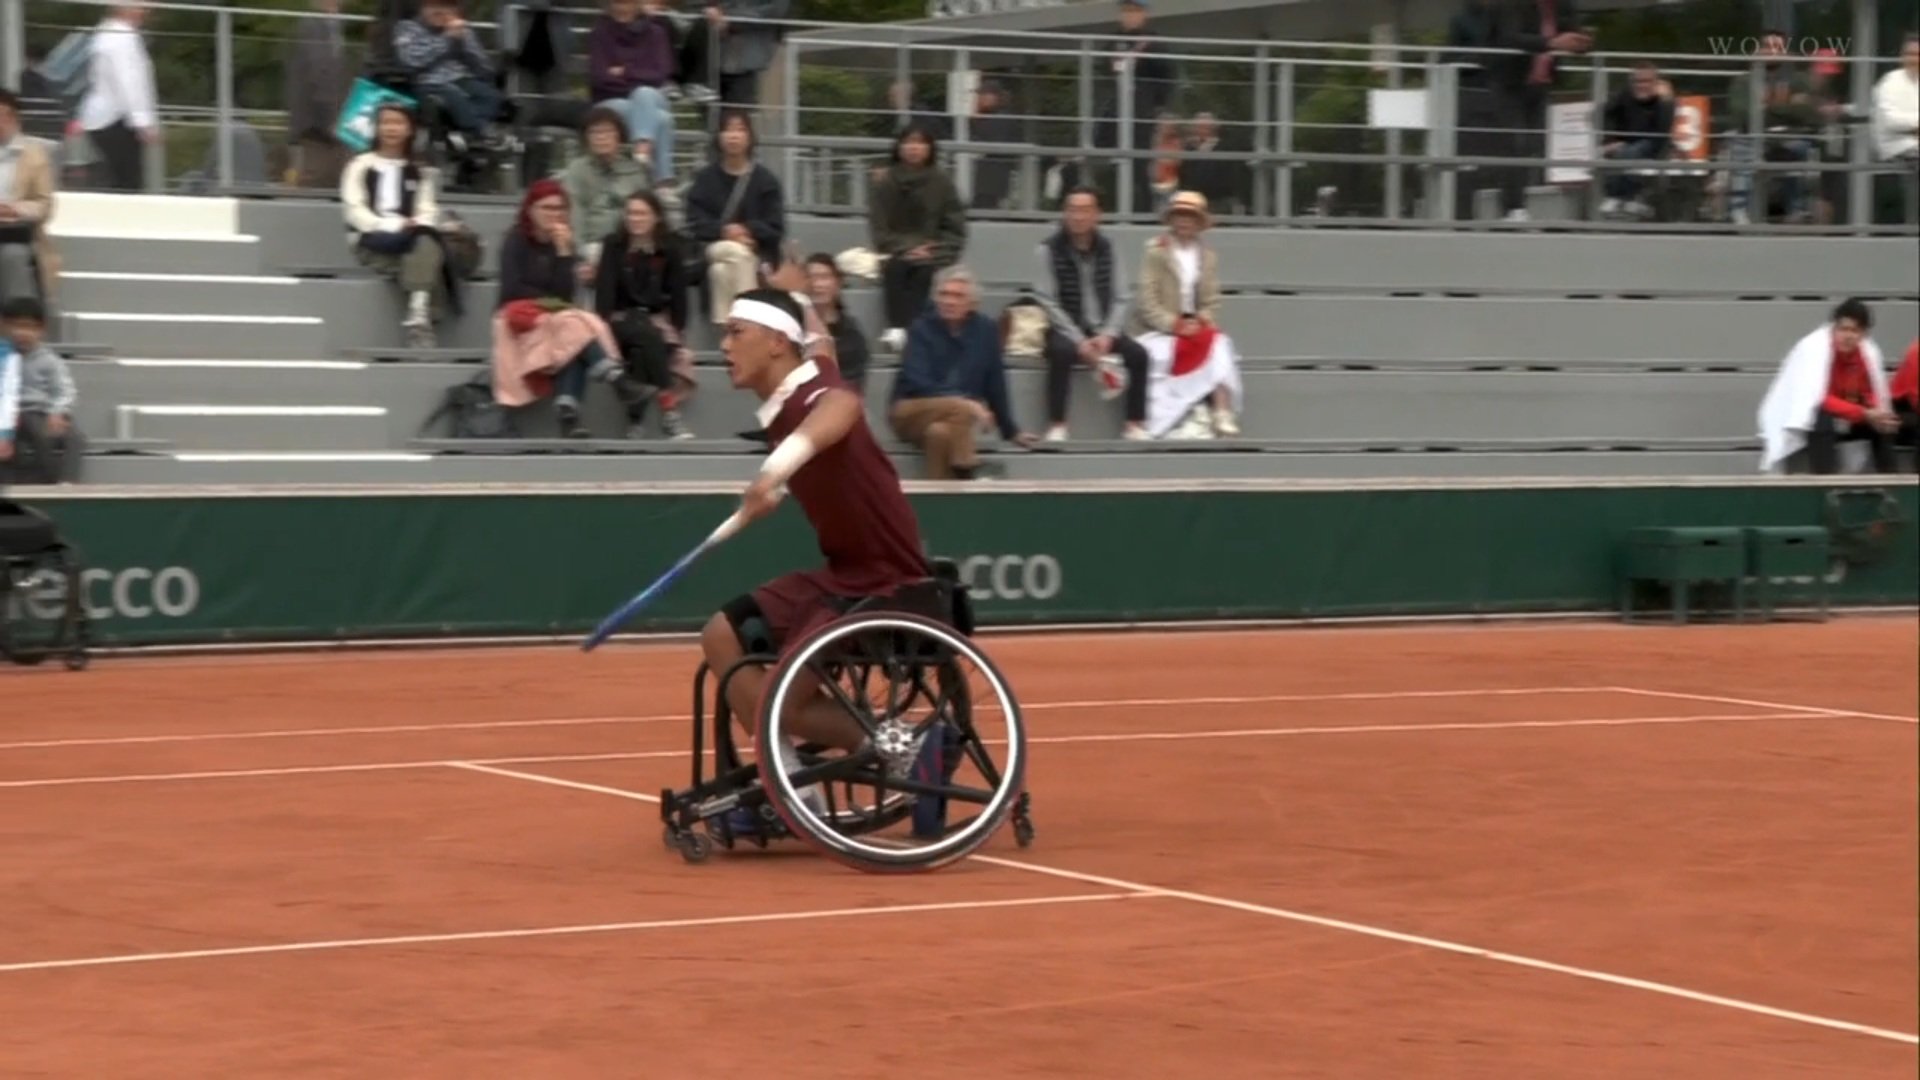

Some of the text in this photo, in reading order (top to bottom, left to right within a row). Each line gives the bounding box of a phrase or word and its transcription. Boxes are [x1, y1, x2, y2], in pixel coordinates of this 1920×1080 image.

[1673, 106, 1701, 150] 3
[8, 566, 199, 618] ecco
[962, 554, 1061, 599] cco
